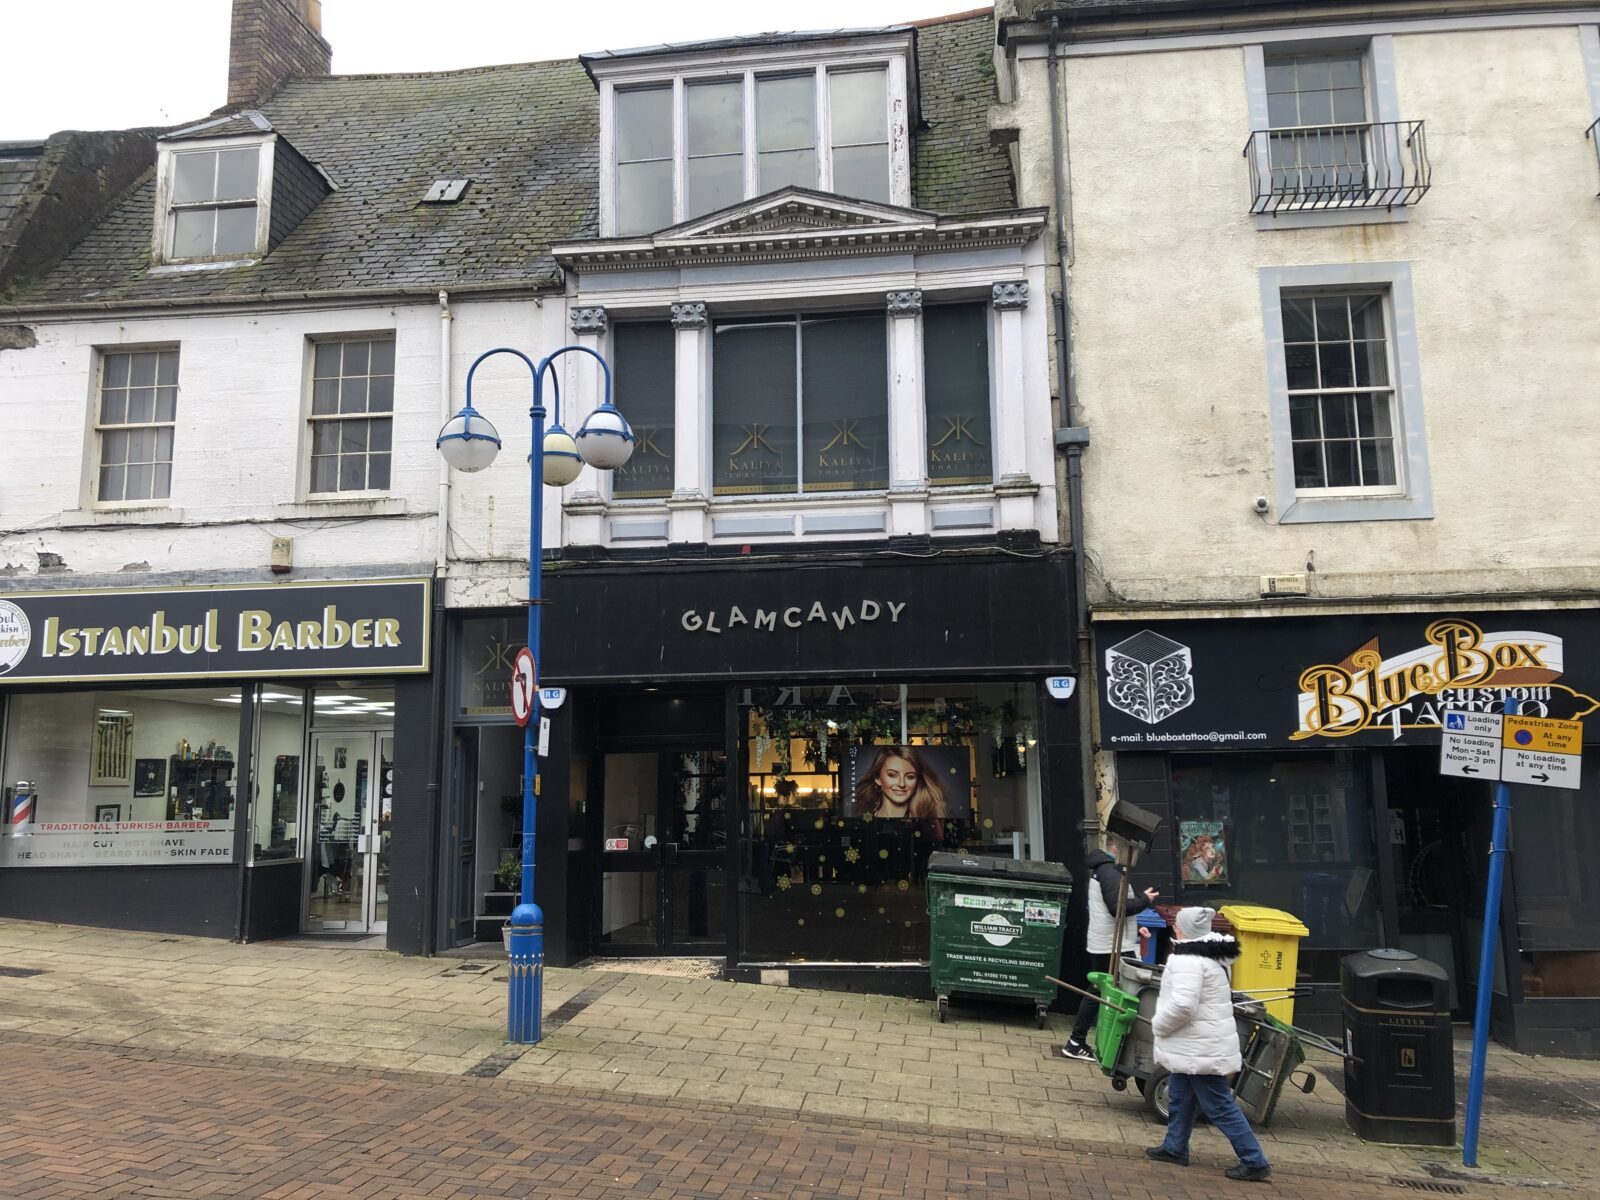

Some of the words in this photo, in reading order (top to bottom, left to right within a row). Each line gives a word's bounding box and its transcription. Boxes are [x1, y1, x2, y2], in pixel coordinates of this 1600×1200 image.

[681, 599, 906, 633] GLAMCANDY
[1467, 715, 1501, 725] Loading
[1508, 717, 1555, 729] Pedestrian
[1558, 721, 1579, 731] Zone
[1474, 724, 1492, 733] only
[1111, 732, 1143, 743] e-mail:
[1146, 730, 1267, 743] blueboxtattoo@gmail.com
[1449, 736, 1461, 744] No
[1464, 737, 1495, 748] loading
[1543, 731, 1553, 739] At
[1556, 733, 1572, 742] any
[1548, 740, 1567, 749] time
[1518, 752, 1530, 760] No
[1534, 753, 1566, 764] loading
[1529, 761, 1544, 770] any
[1548, 763, 1568, 772] time
[40, 822, 111, 831] TRADITIONAL
[115, 822, 162, 830] TURKISH
[166, 821, 210, 829] BARBER
[93, 840, 114, 848] CUT
[149, 838, 186, 847] SHAVE
[17, 851, 47, 859] HEAD
[170, 848, 197, 857] SKIN
[201, 848, 230, 856] FADE
[973, 923, 998, 932] WILLIAM
[998, 925, 1020, 934] TRACEY
[946, 953, 964, 961] TRADE
[964, 954, 983, 962] WASTE
[987, 956, 1018, 966] RECYCLING
[1018, 959, 1045, 968] SERVICES
